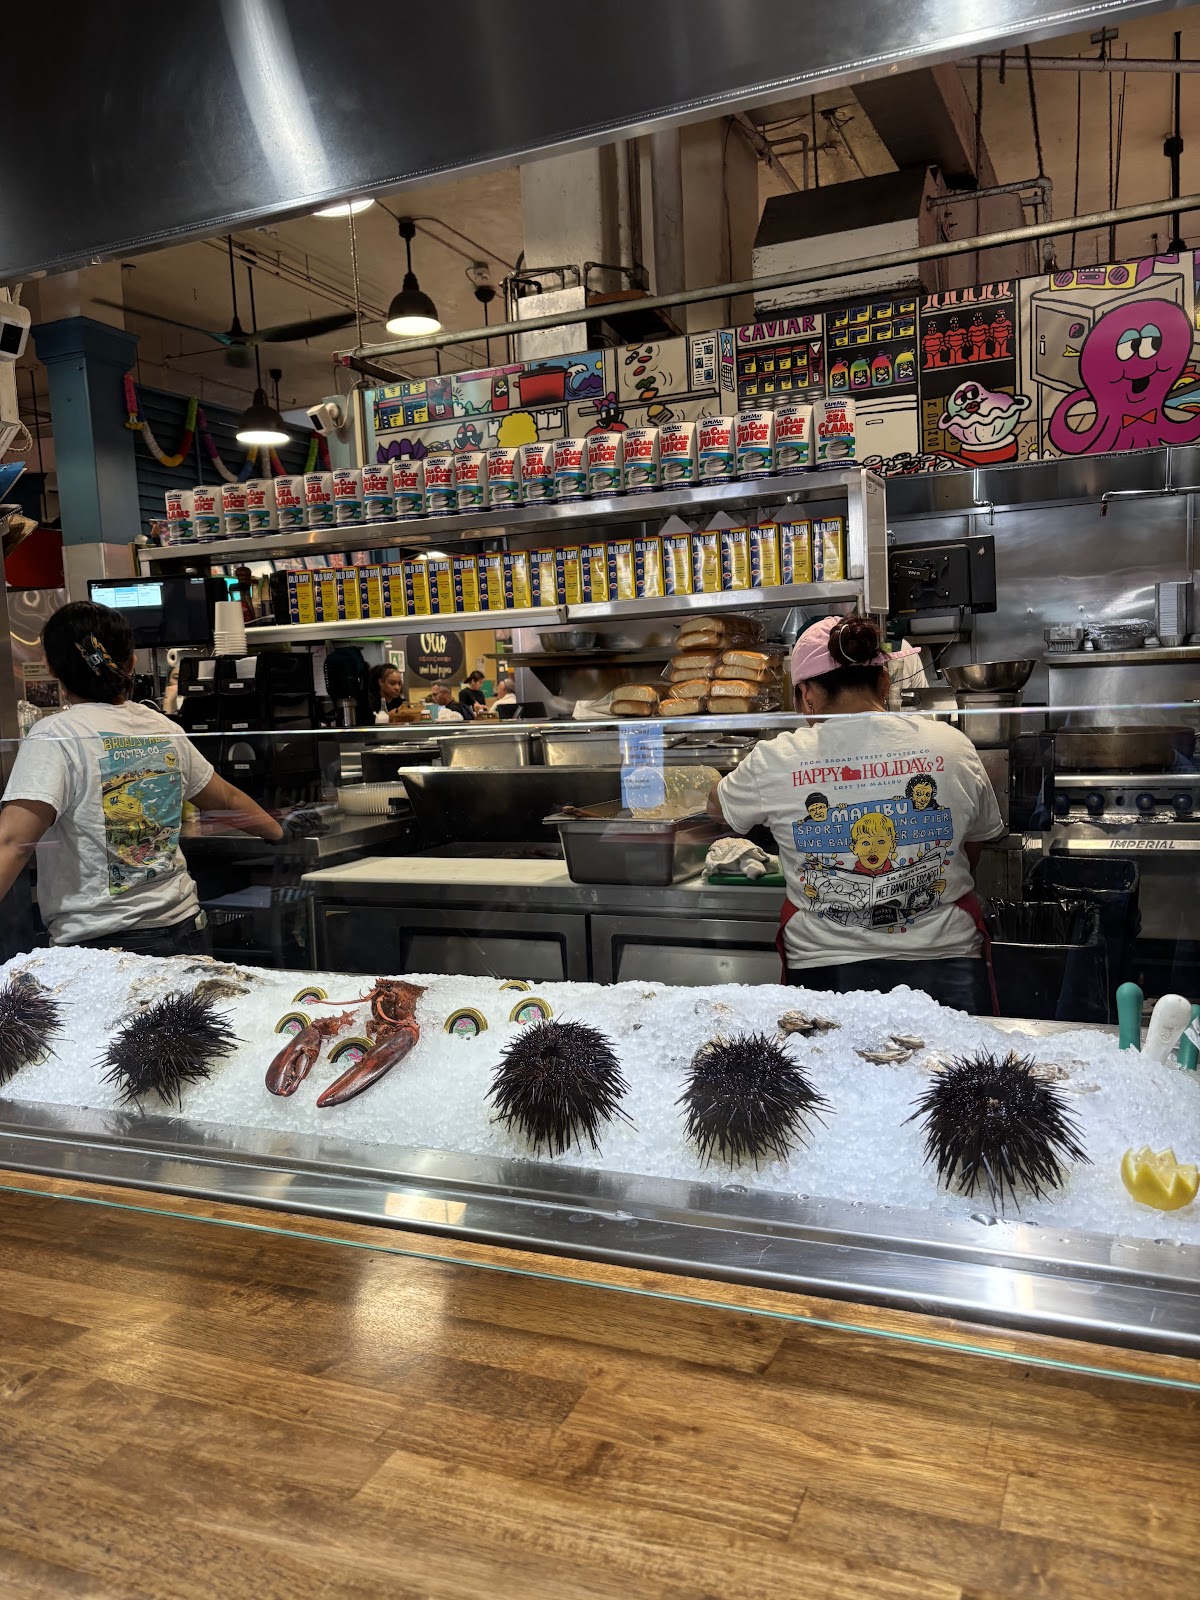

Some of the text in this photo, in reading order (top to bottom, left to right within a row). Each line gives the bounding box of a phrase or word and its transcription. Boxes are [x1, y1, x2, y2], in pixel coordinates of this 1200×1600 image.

[739, 315, 816, 342] CAVIAR
[784, 416, 805, 424] CLAM
[826, 414, 846, 423] SEA
[710, 427, 730, 435] CLAM
[737, 422, 768, 433] SEA CLAM
[775, 424, 803, 441] JUICE
[818, 422, 853, 435] CLAMS
[634, 438, 653, 446] CLAM
[669, 433, 689, 441] CLAM
[737, 431, 767, 447] JUICE
[699, 436, 729, 451] JUICE
[564, 448, 582, 456] CLAM
[625, 446, 651, 462] JUICE
[661, 441, 687, 457] JUICE
[526, 458, 543, 466] SEA
[555, 456, 581, 471] JUICE
[589, 451, 615, 467] JUICE
[488, 465, 513, 480] JUICE
[522, 466, 551, 476] CLAMS
[426, 474, 451, 487] JUICE
[783, 525, 808, 536] OLD BAY
[814, 521, 840, 532] OLD BAY
[722, 532, 746, 543] OLD BAY
[751, 529, 774, 539] OLD BAY
[665, 538, 687, 548] OLD BAY
[693, 535, 716, 546] OLD BAY
[608, 543, 630, 554] OLD BAY
[636, 541, 658, 551] OLD BAY
[531, 552, 552, 562] OLD BAY
[557, 550, 577, 560] OLD BAY
[582, 548, 603, 558] OLD BAY
[454, 559, 474, 569] OLD BAY
[479, 557, 500, 567] OLD BAY
[504, 555, 524, 564] OLD BAY
[382, 566, 401, 576] OLD BAY
[405, 564, 424, 573] OLD BAY
[429, 562, 449, 571] OLD BAY
[314, 572, 333, 581] OLD BAY
[336, 570, 356, 580] OLD BAY
[360, 568, 379, 578] OLD BAY
[289, 574, 309, 583] OLD BAY
[793, 767, 840, 787] HAPPY
[936, 756, 944, 772] 2
[798, 825, 843, 835] SPORT
[924, 814, 949, 823] PIER
[798, 838, 822, 847] LIVE
[913, 827, 949, 838] BOATS
[1109, 840, 1176, 849] IMPERIAL
[891, 878, 914, 894] BANDITS
